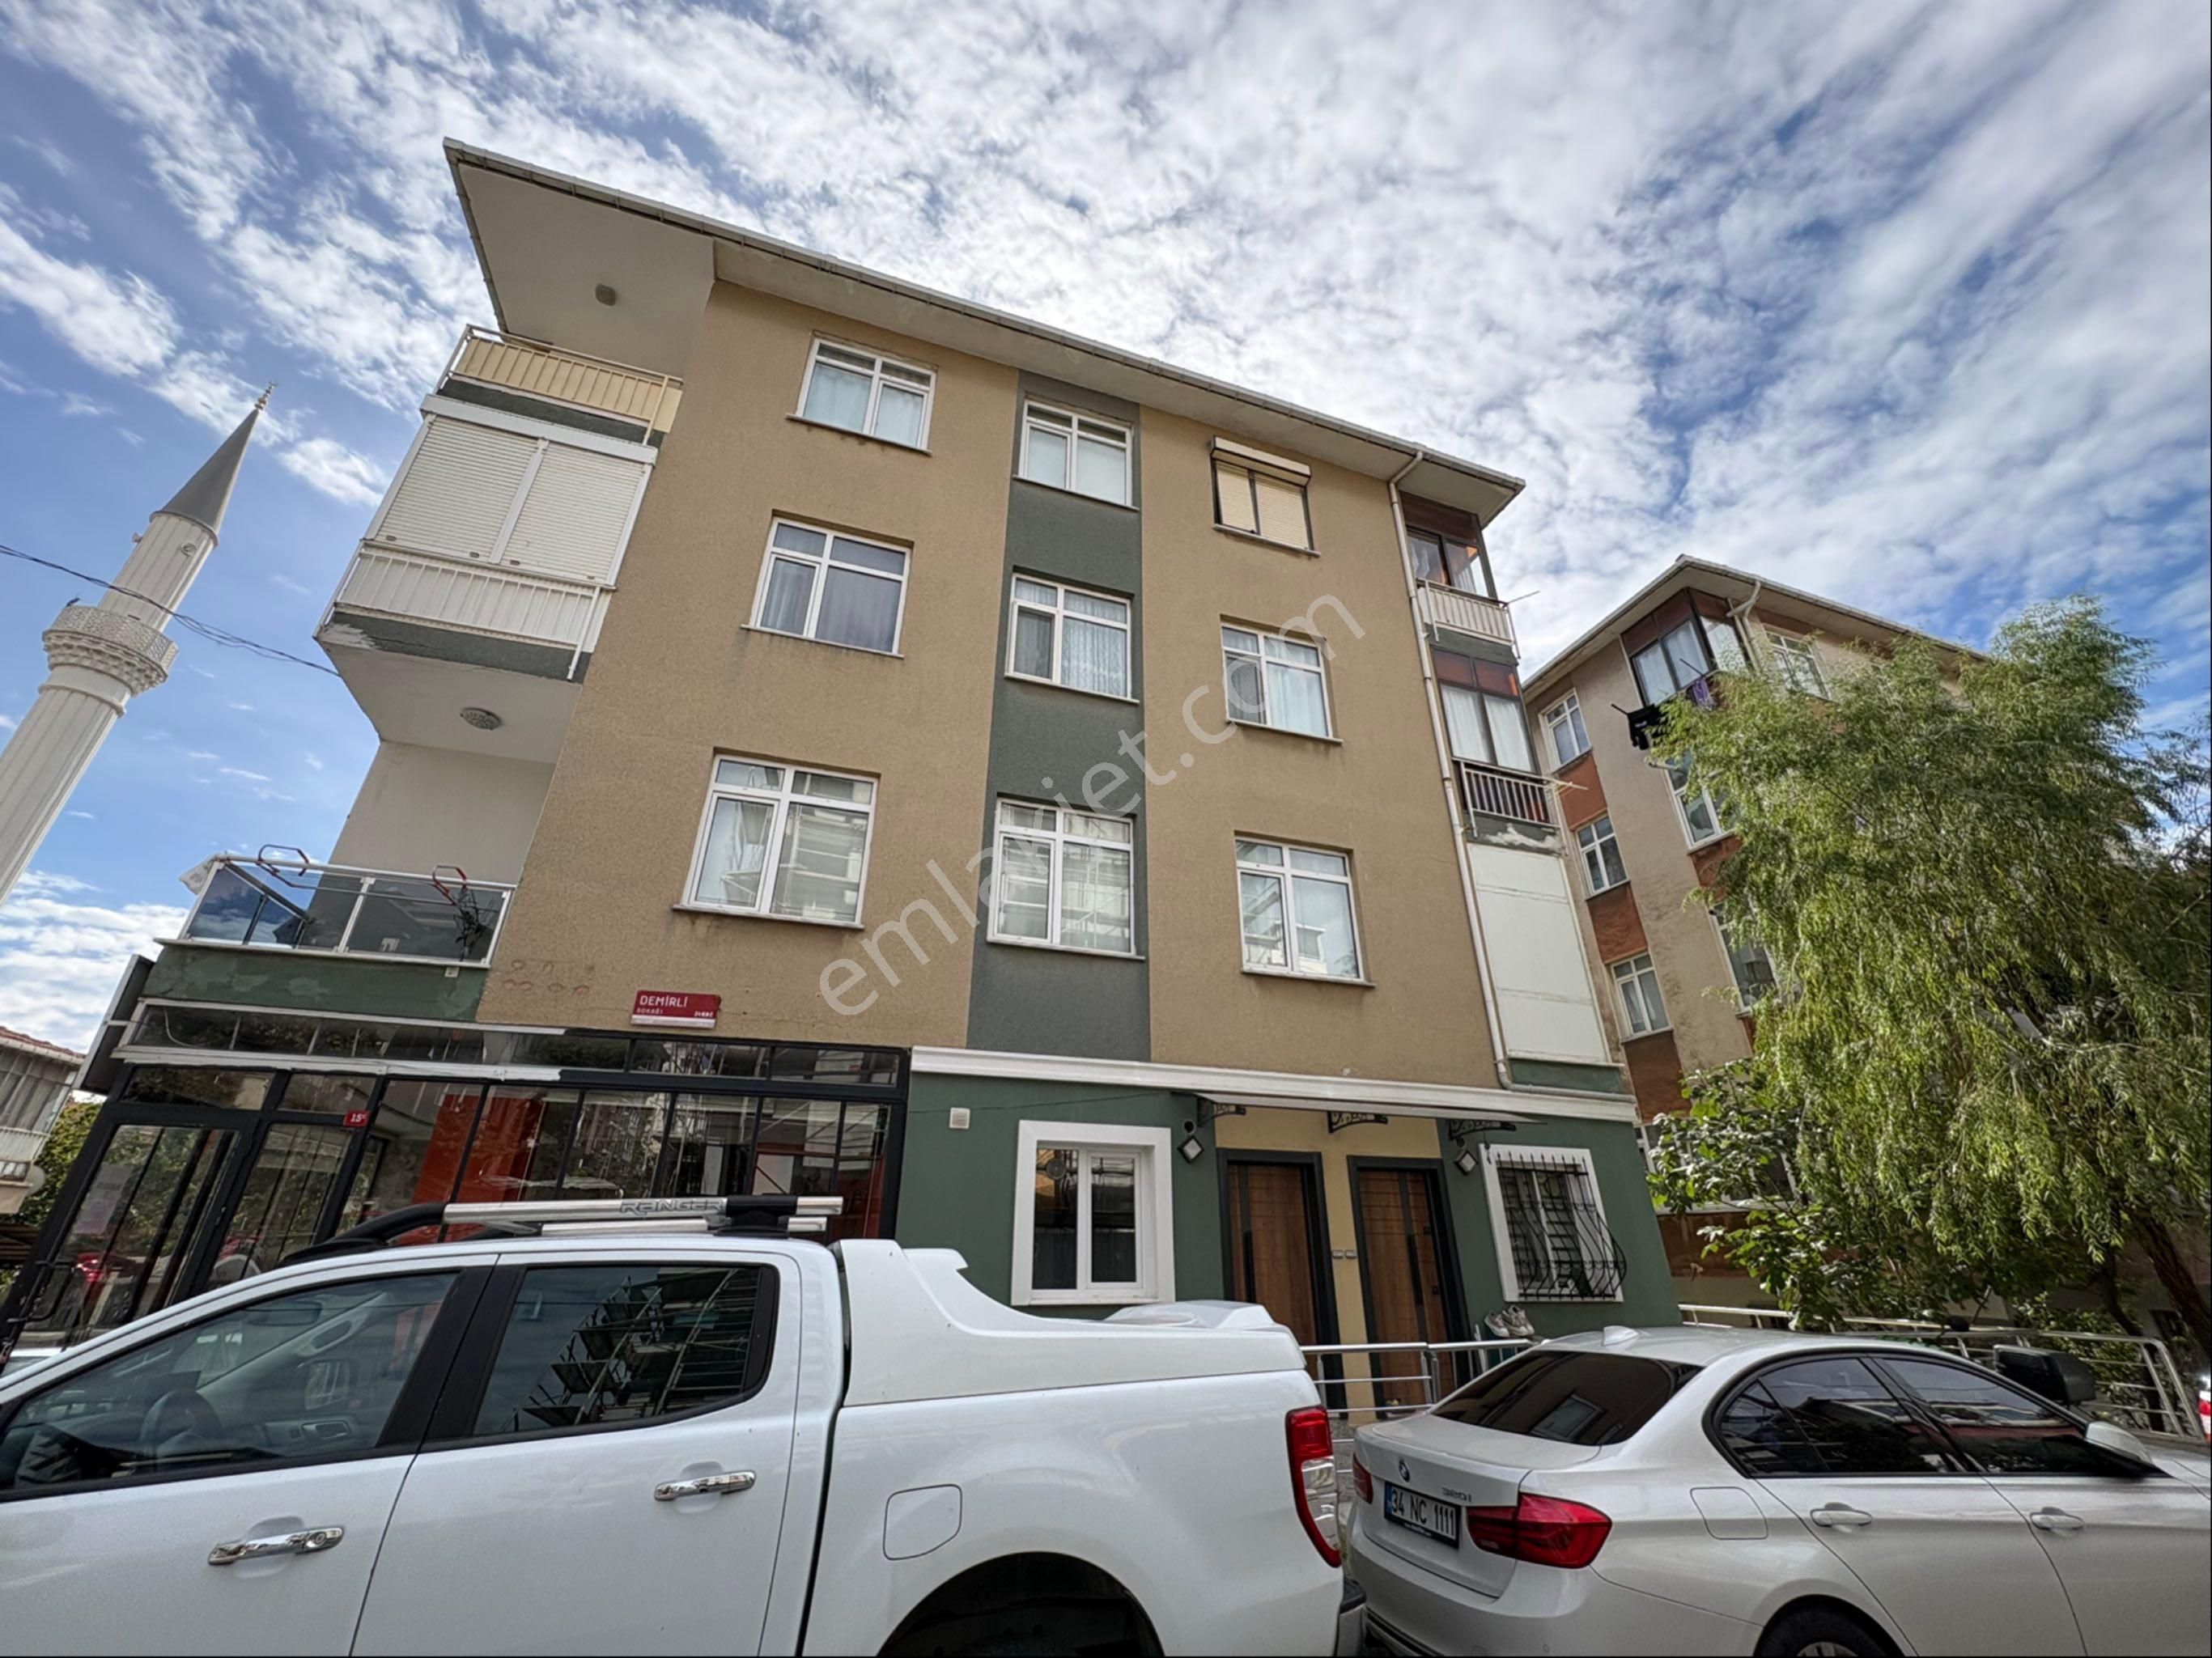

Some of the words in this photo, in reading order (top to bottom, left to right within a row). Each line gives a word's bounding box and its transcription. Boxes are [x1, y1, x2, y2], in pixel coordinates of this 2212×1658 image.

[639, 994, 688, 1008] DEMİRLİ
[620, 1198, 724, 1215] RANGER
[1391, 1489, 1404, 1516] 34
[1410, 1495, 1427, 1524] NC
[1434, 1503, 1454, 1537] 1111
